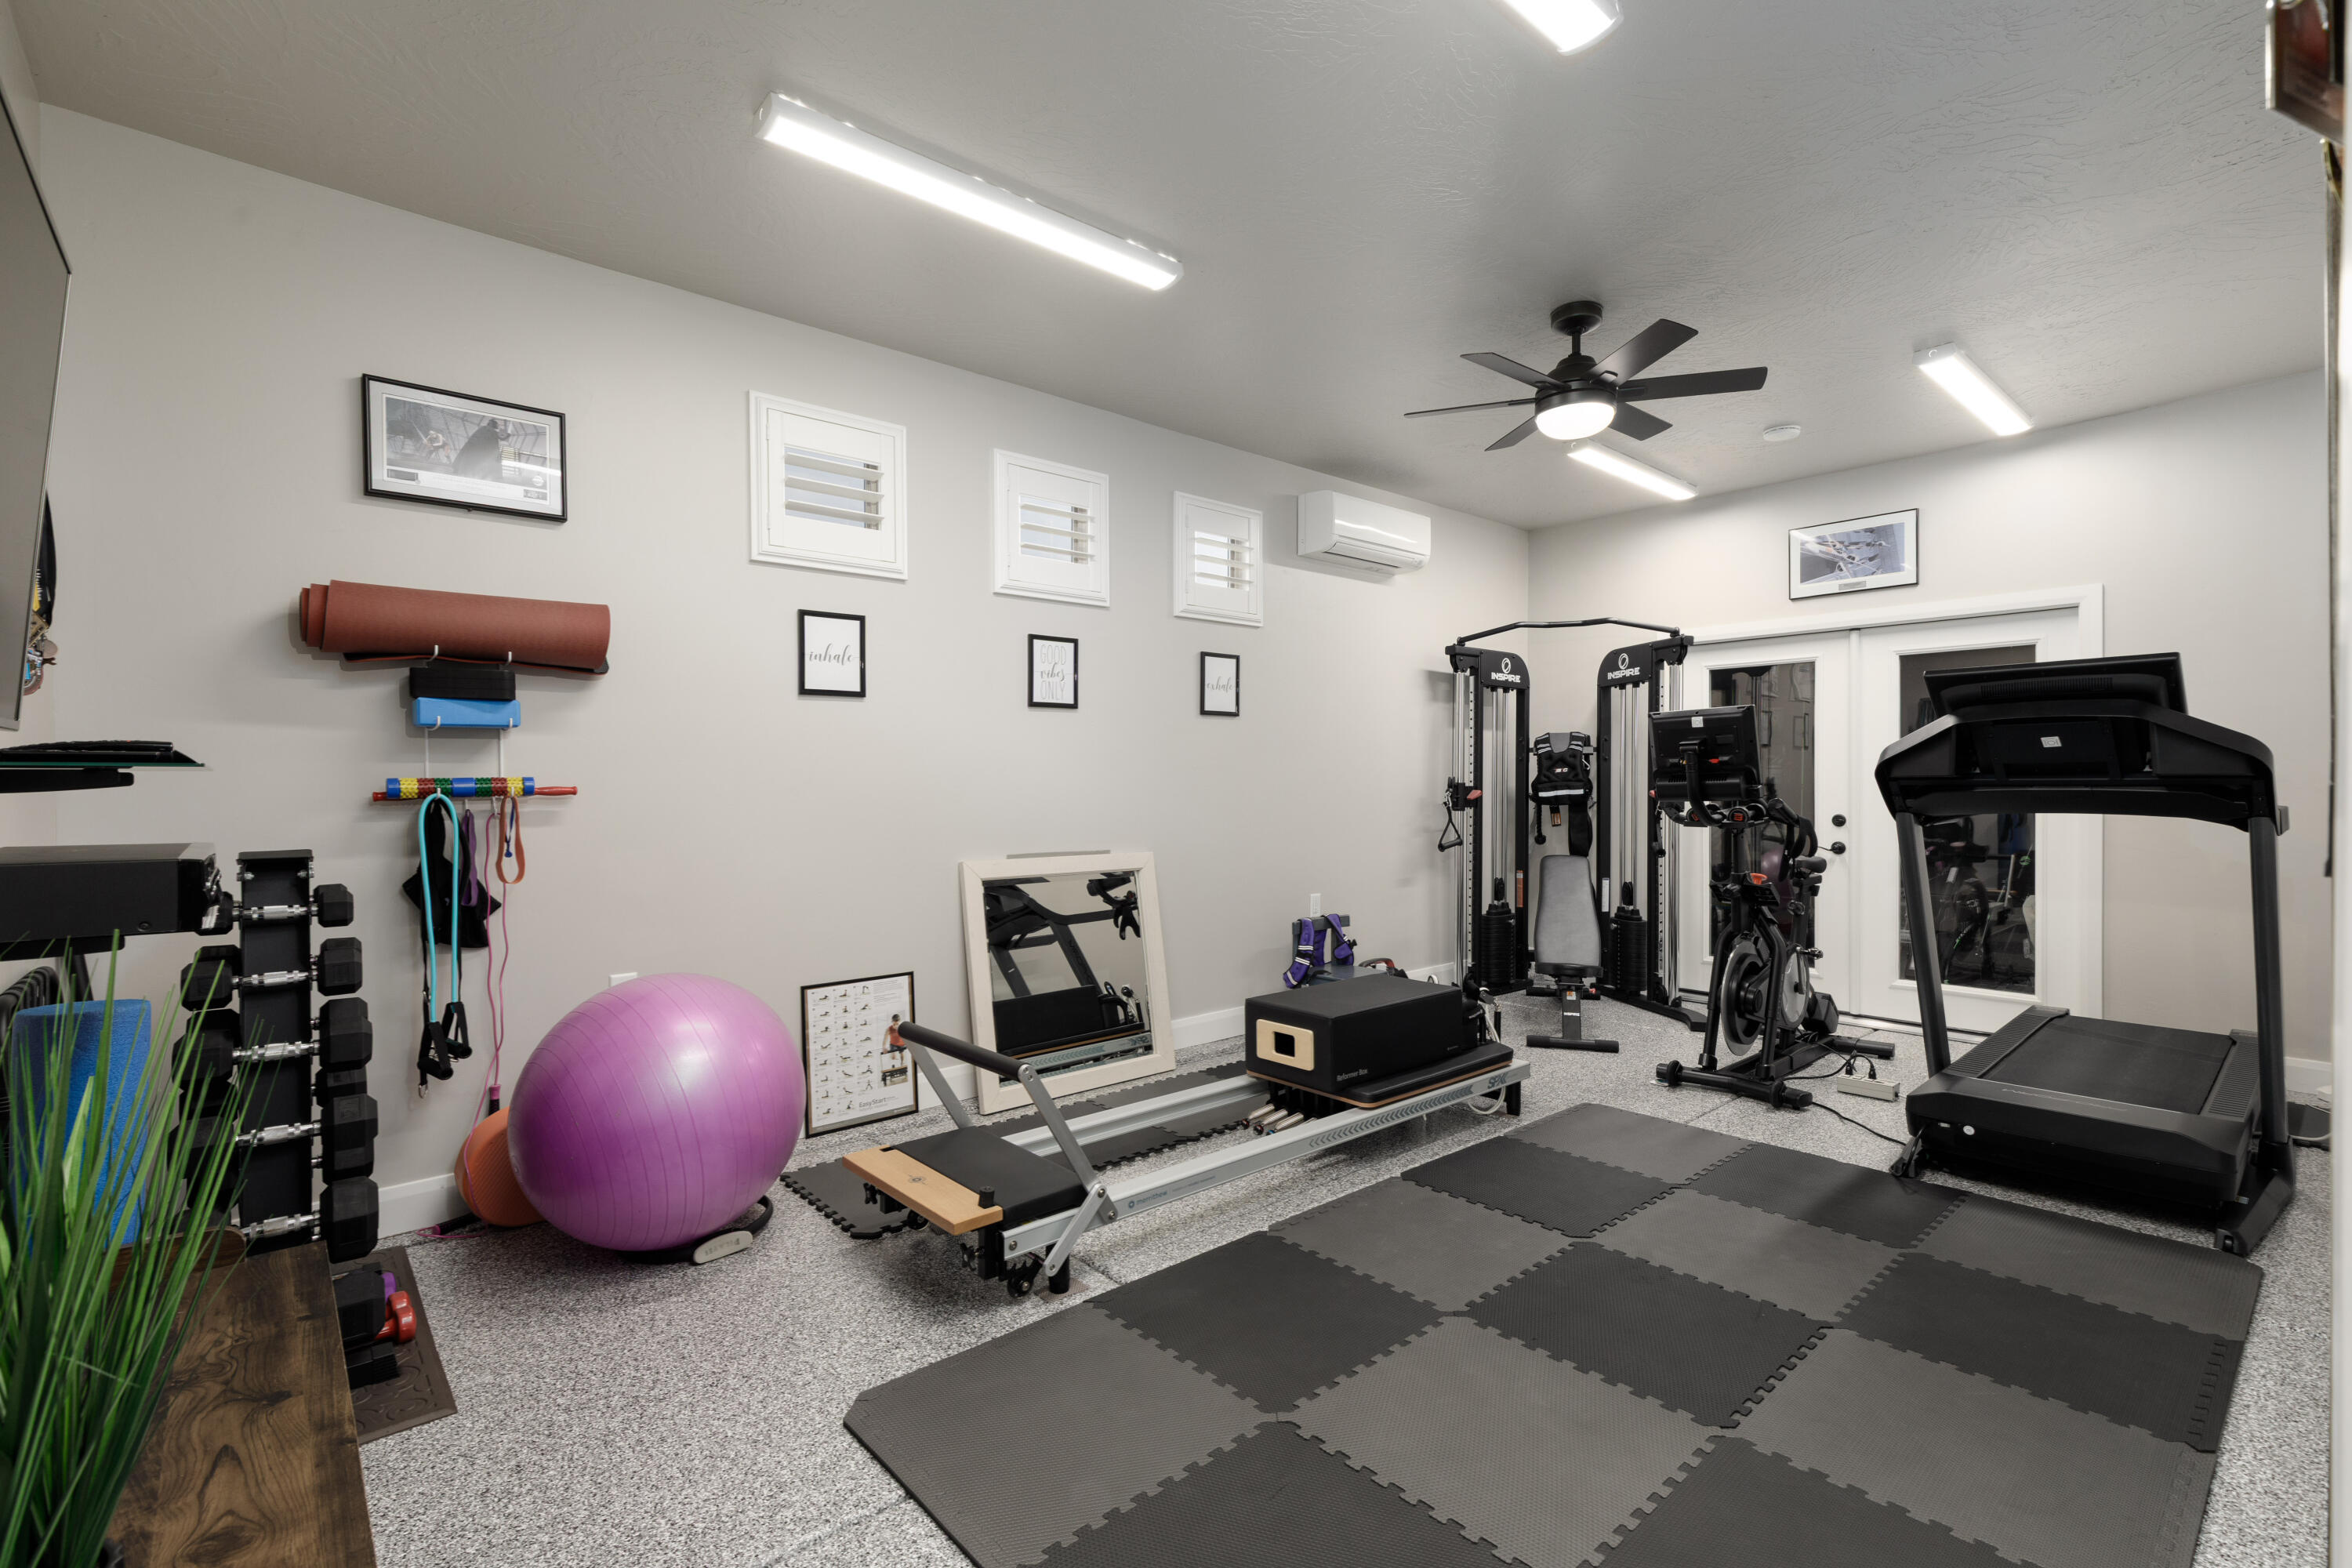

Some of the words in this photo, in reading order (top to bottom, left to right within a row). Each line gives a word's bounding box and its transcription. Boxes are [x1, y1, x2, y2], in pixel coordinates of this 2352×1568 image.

[808, 643, 854, 666] inhale
[1040, 644, 1066, 665] GOOD
[1040, 662, 1066, 682] vibes
[1491, 672, 1521, 683] INSPIRE
[1607, 667, 1640, 680] INSPIRE
[1040, 681, 1066, 701] ONLY
[1207, 676, 1233, 693] exhale
[1336, 1071, 1358, 1082] Reformer
